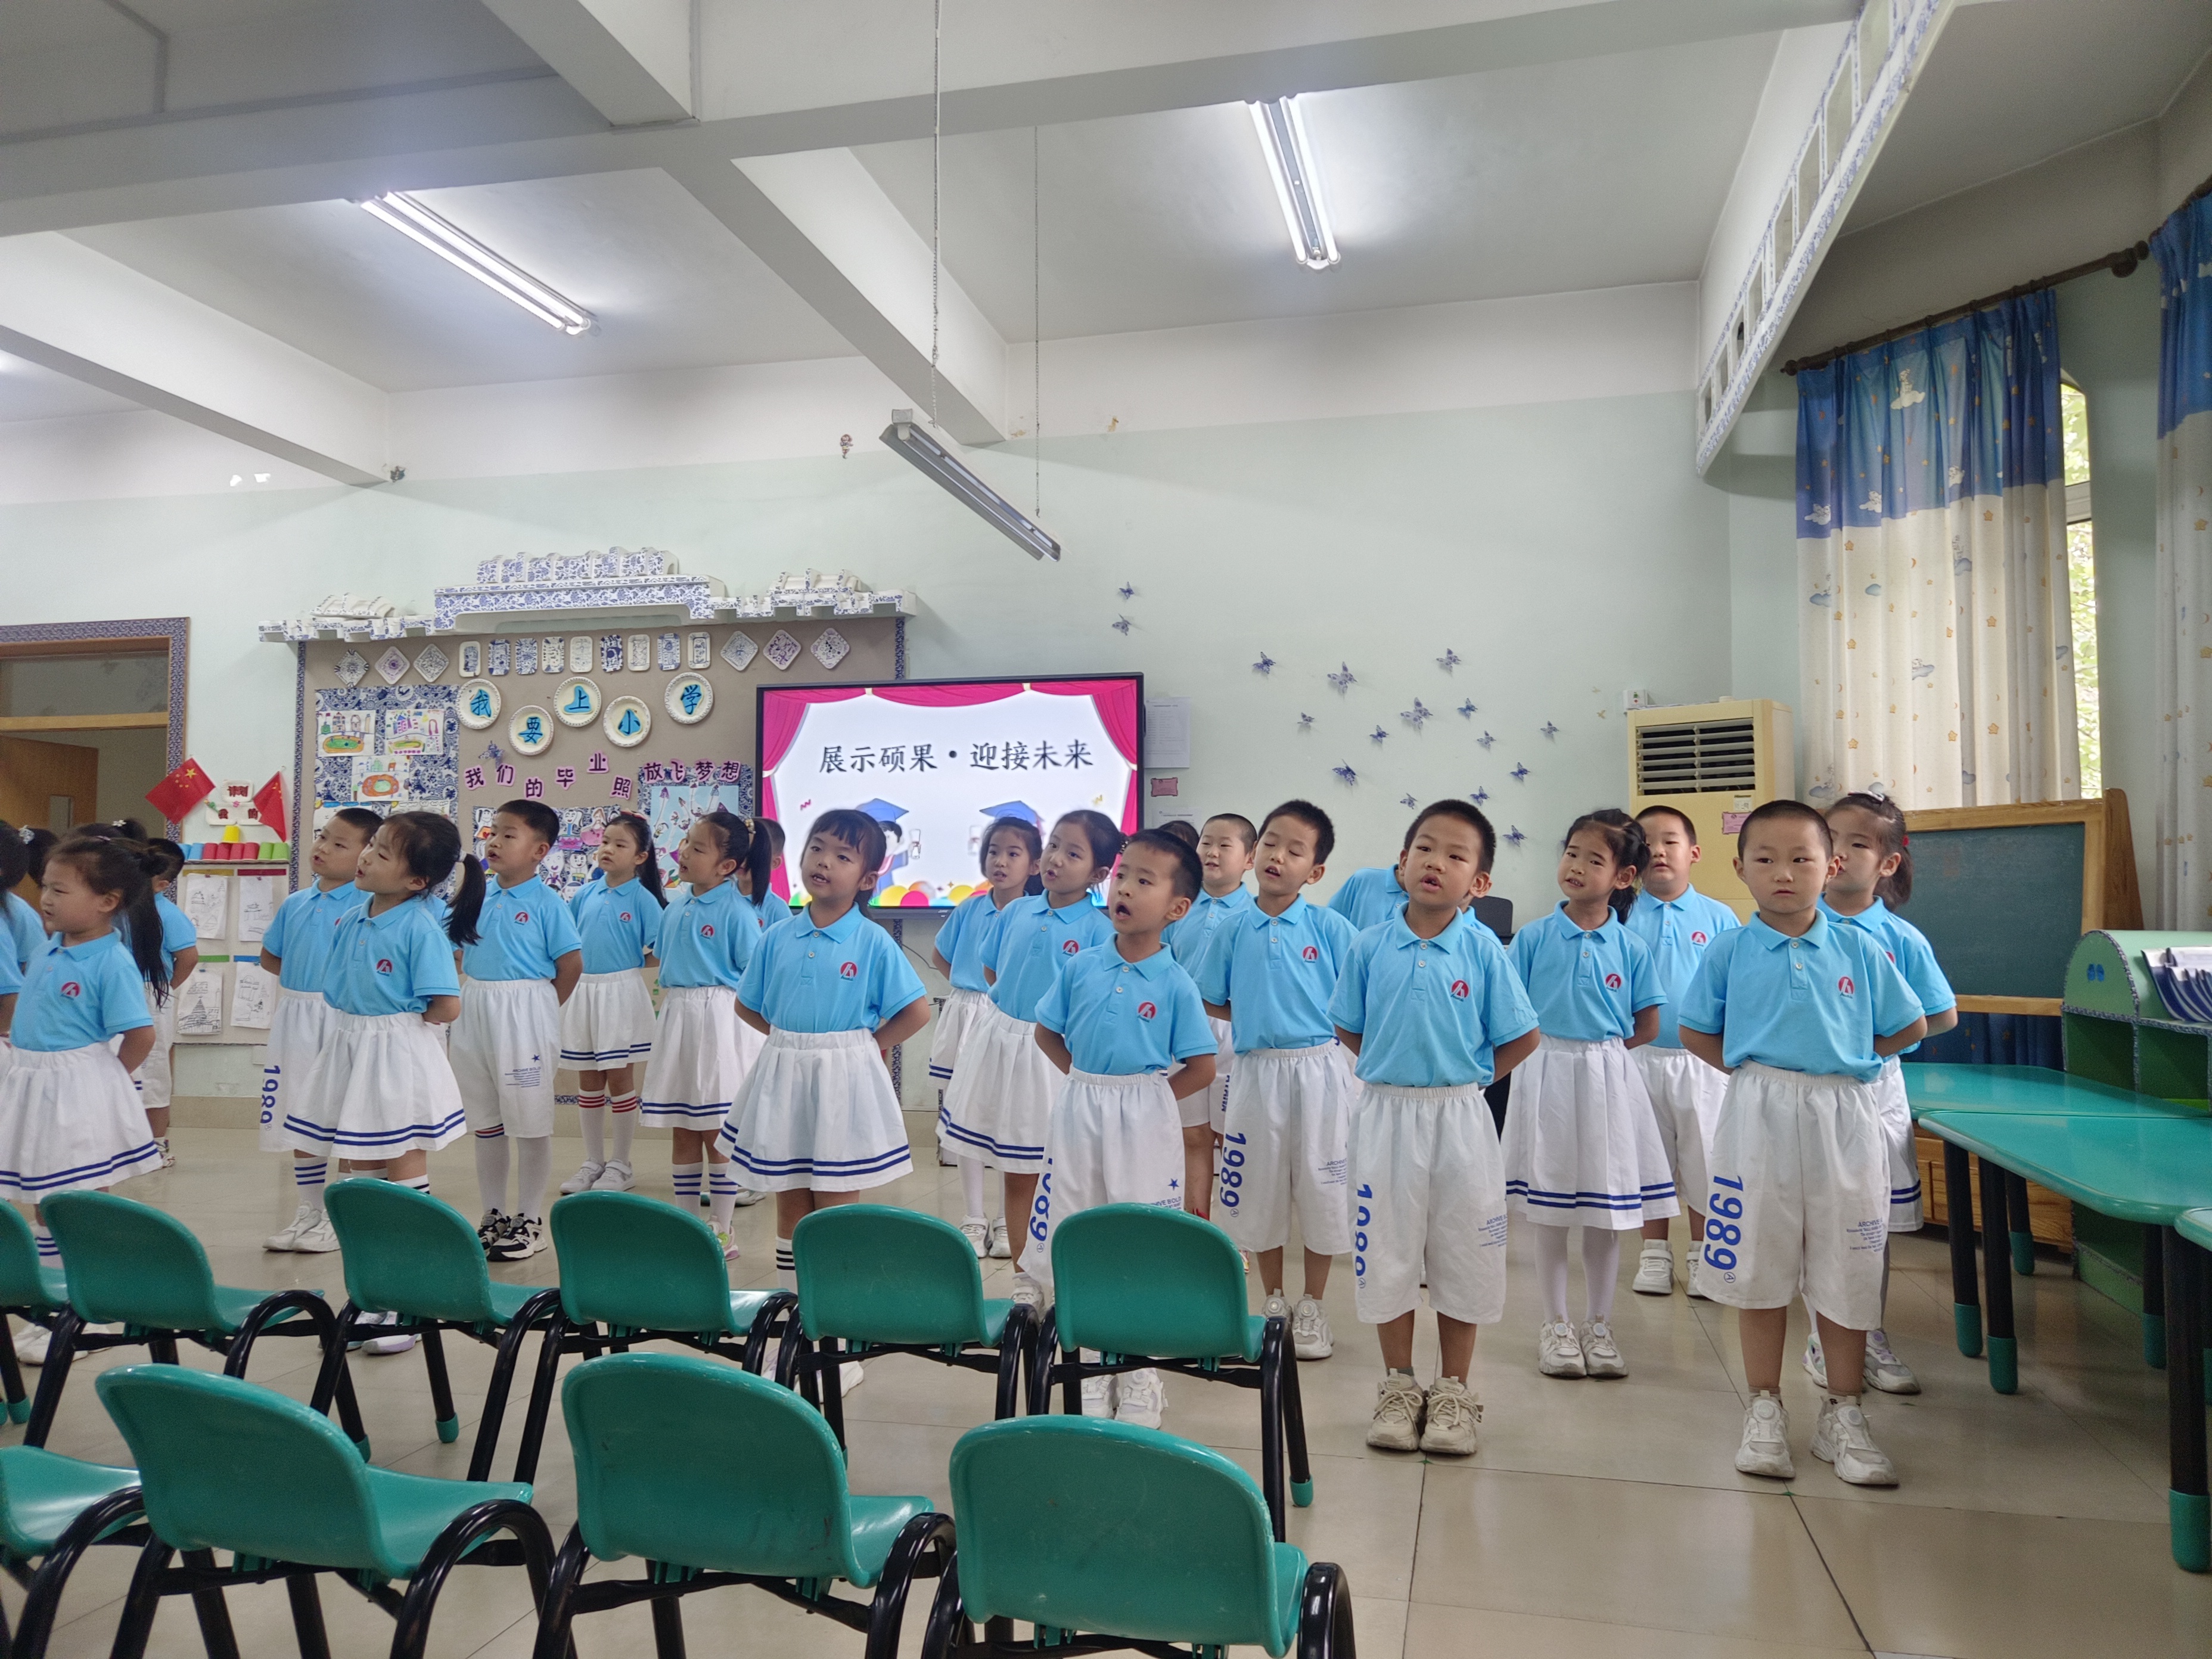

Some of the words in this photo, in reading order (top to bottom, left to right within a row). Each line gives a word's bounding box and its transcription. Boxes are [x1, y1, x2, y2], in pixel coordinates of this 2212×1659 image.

[470, 684, 701, 744] 我要上小学
[465, 753, 631, 799] 我们的毕业照
[644, 760, 741, 782] 放飞梦想
[1220, 1132, 1247, 1207] 1989
[1704, 1175, 1744, 1270] 1989
